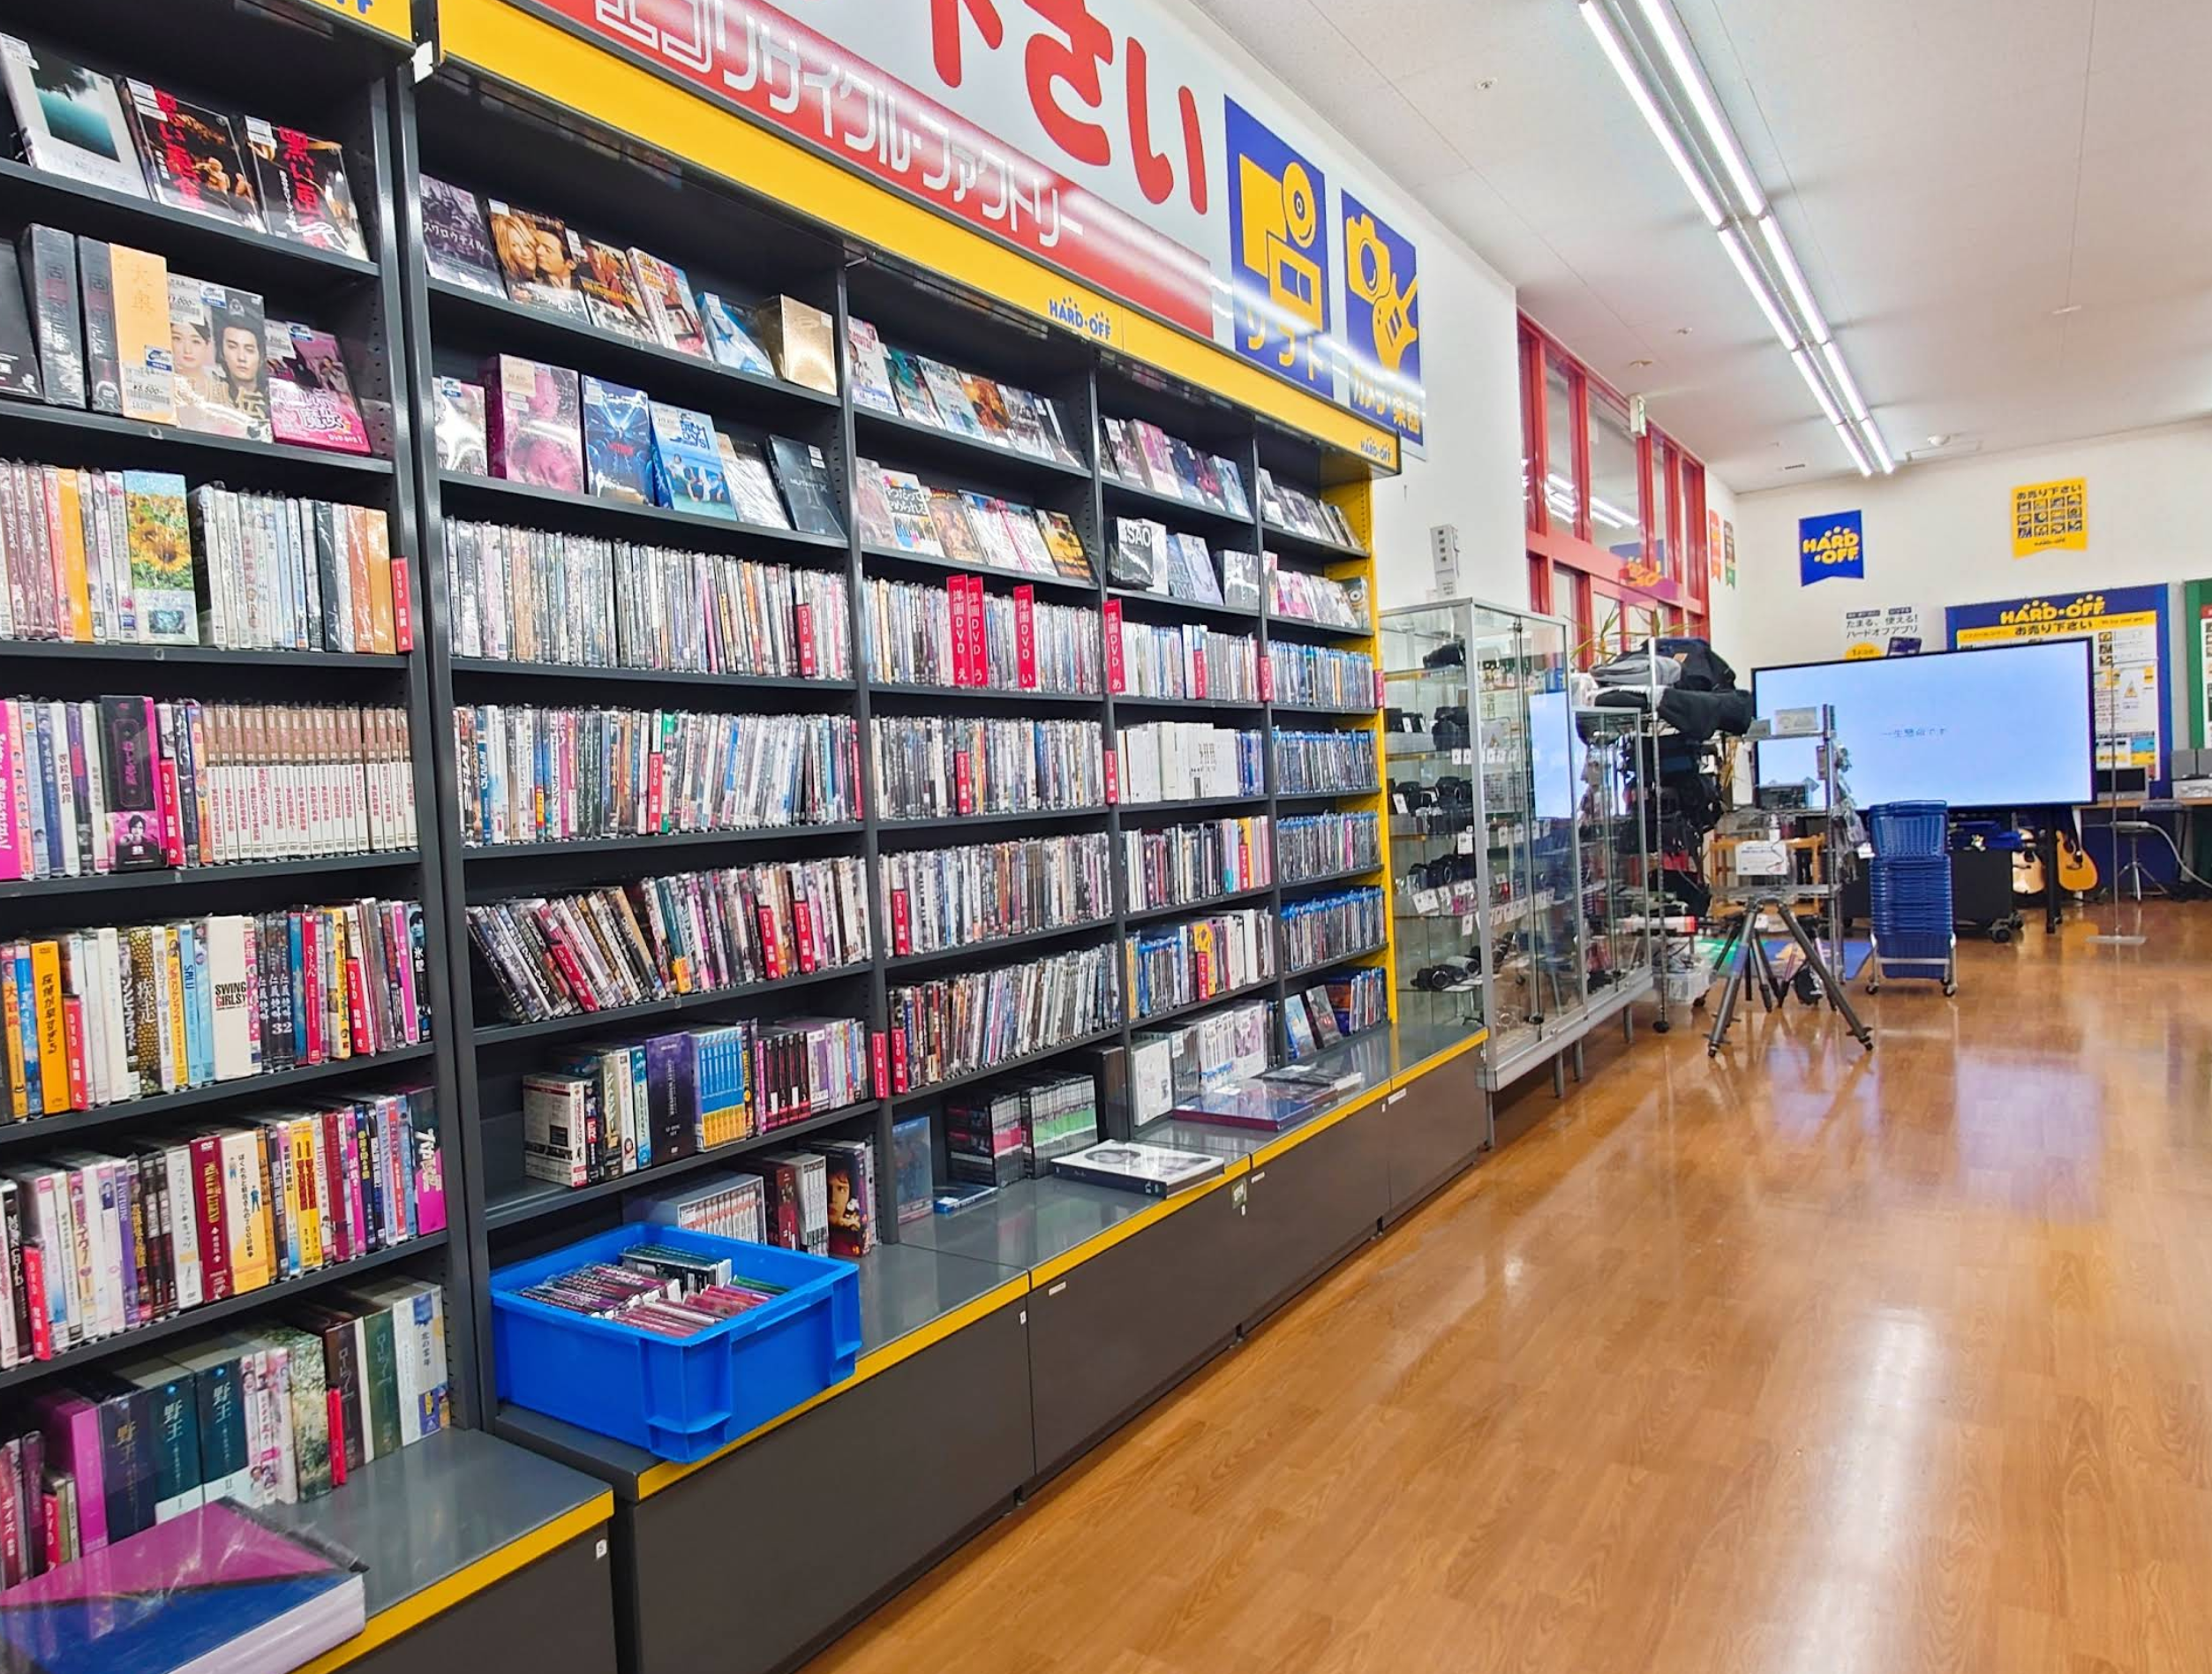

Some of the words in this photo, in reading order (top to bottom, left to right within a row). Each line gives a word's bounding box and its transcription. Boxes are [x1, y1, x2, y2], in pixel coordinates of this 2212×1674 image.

[424, 221, 486, 252] スワロウテイル
[2017, 484, 2082, 500] お売り下さい
[1802, 532, 1860, 554] HARD
[953, 589, 966, 654] 洋画DVD
[1019, 599, 1030, 660] 洋画DVD
[2014, 620, 2094, 637] お売り下さい
[1107, 611, 1119, 667] 洋画DVD
[958, 670, 967, 682] え
[973, 670, 982, 681] う
[1022, 673, 1032, 684] い
[558, 949, 573, 975] DVD
[214, 981, 246, 995] SWING
[349, 970, 357, 999] DVD
[215, 992, 246, 1006] GIRLS
[68, 1014, 78, 1047] DVD
